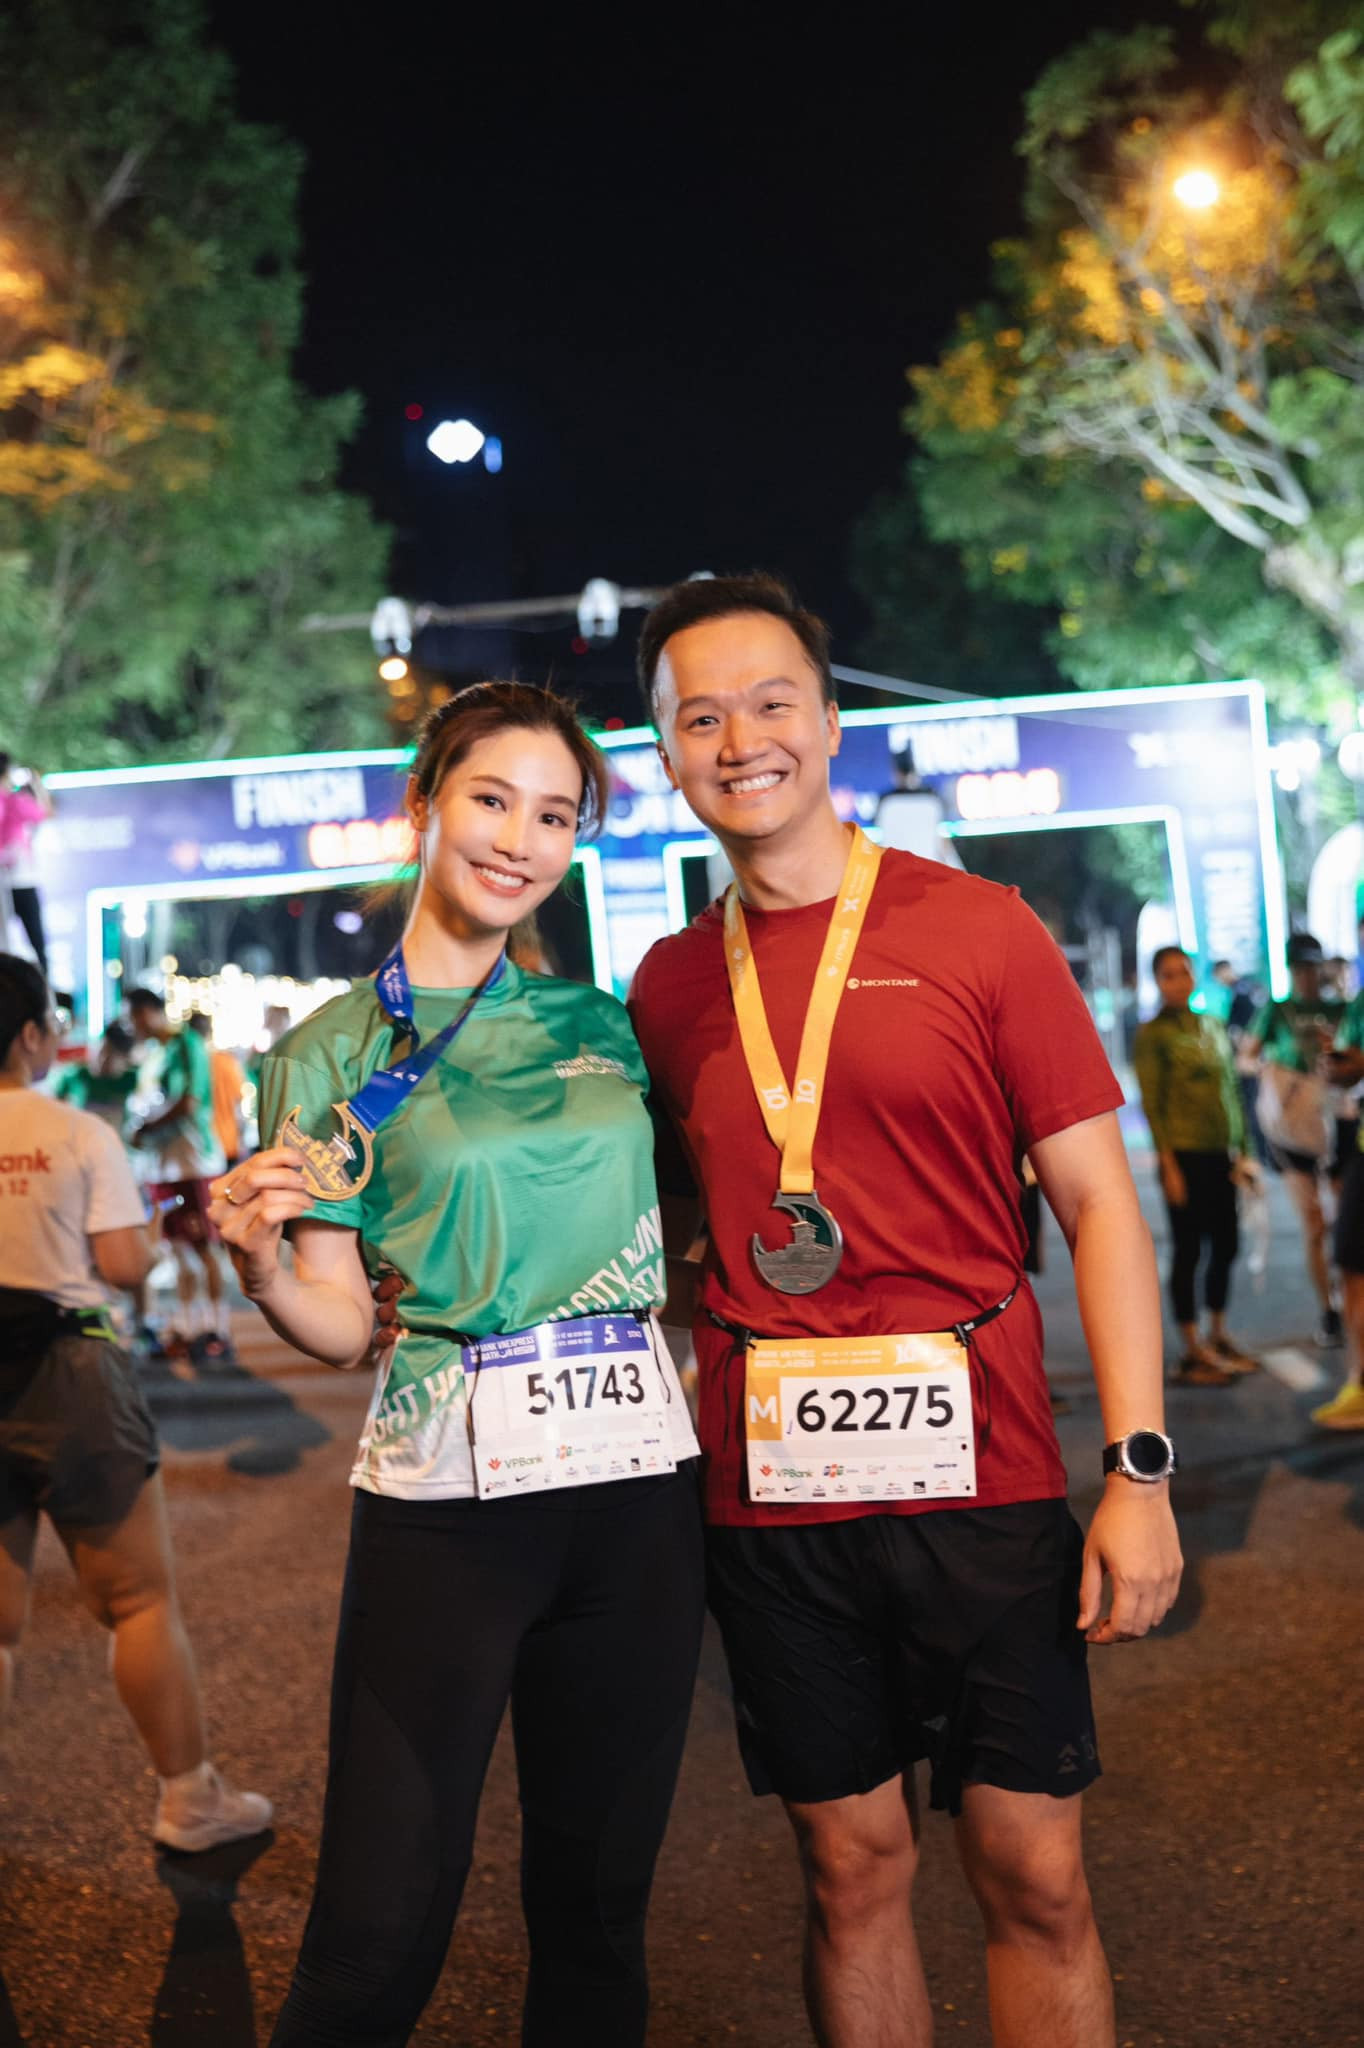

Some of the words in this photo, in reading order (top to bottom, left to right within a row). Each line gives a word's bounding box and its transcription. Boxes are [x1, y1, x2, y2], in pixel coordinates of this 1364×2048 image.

[861, 978, 920, 987] MONTANE
[528, 1363, 645, 1415] 51743
[750, 1396, 777, 1424] M
[797, 1385, 954, 1432] 62275
[505, 1454, 543, 1468] VPBank
[776, 1468, 814, 1479] VPBank
